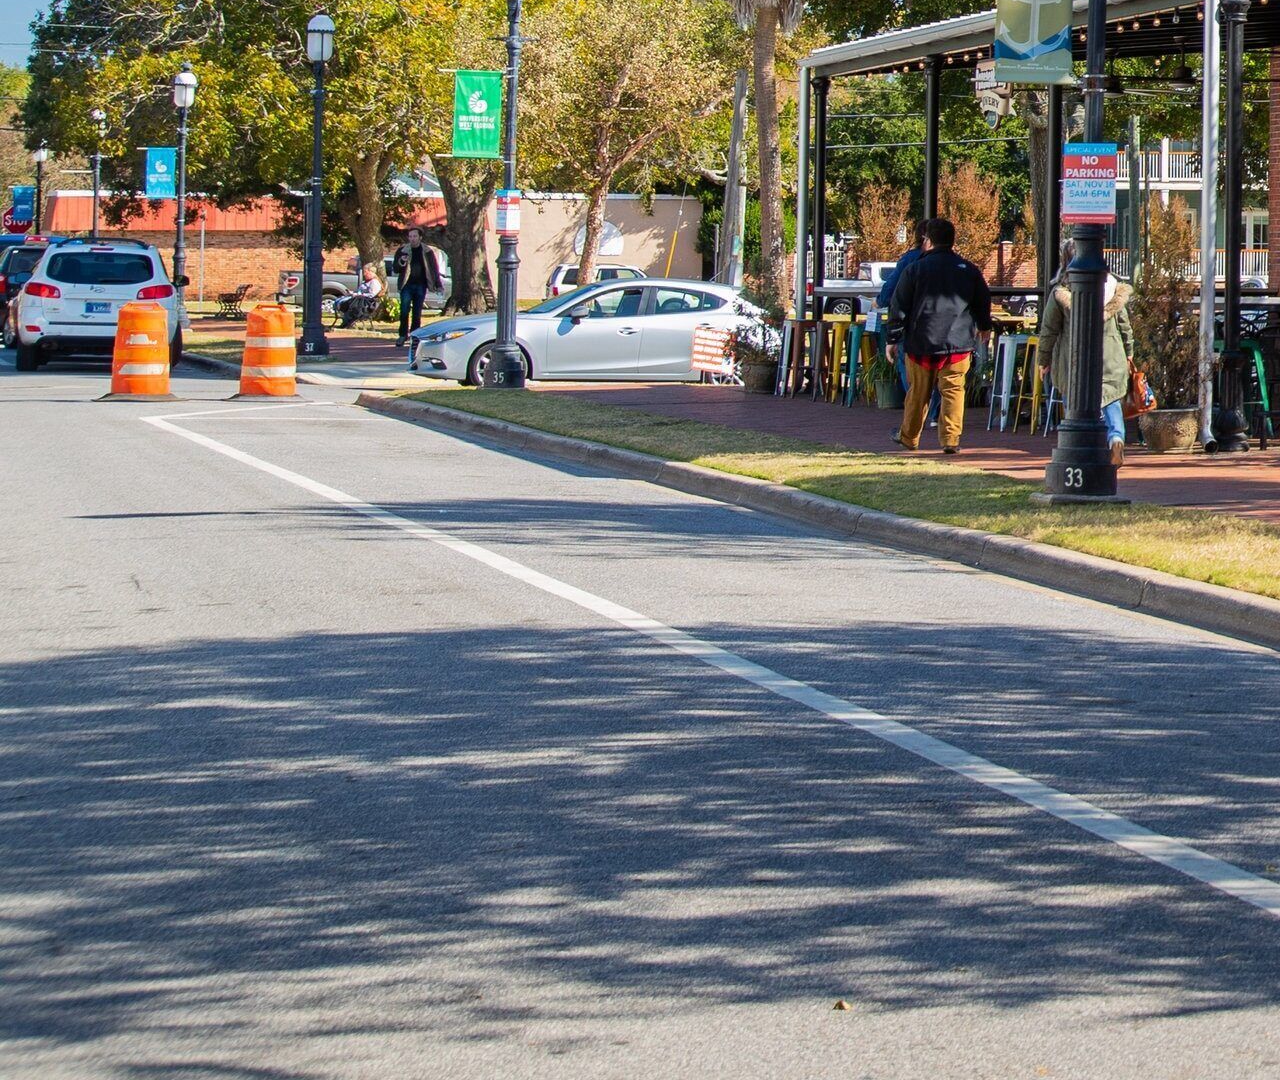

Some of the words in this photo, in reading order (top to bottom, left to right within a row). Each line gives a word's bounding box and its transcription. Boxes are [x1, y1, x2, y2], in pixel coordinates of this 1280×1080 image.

[1081, 156, 1099, 165] NO
[1065, 168, 1115, 178] PARKING
[493, 371, 504, 383] 35
[1064, 467, 1083, 487] 33
